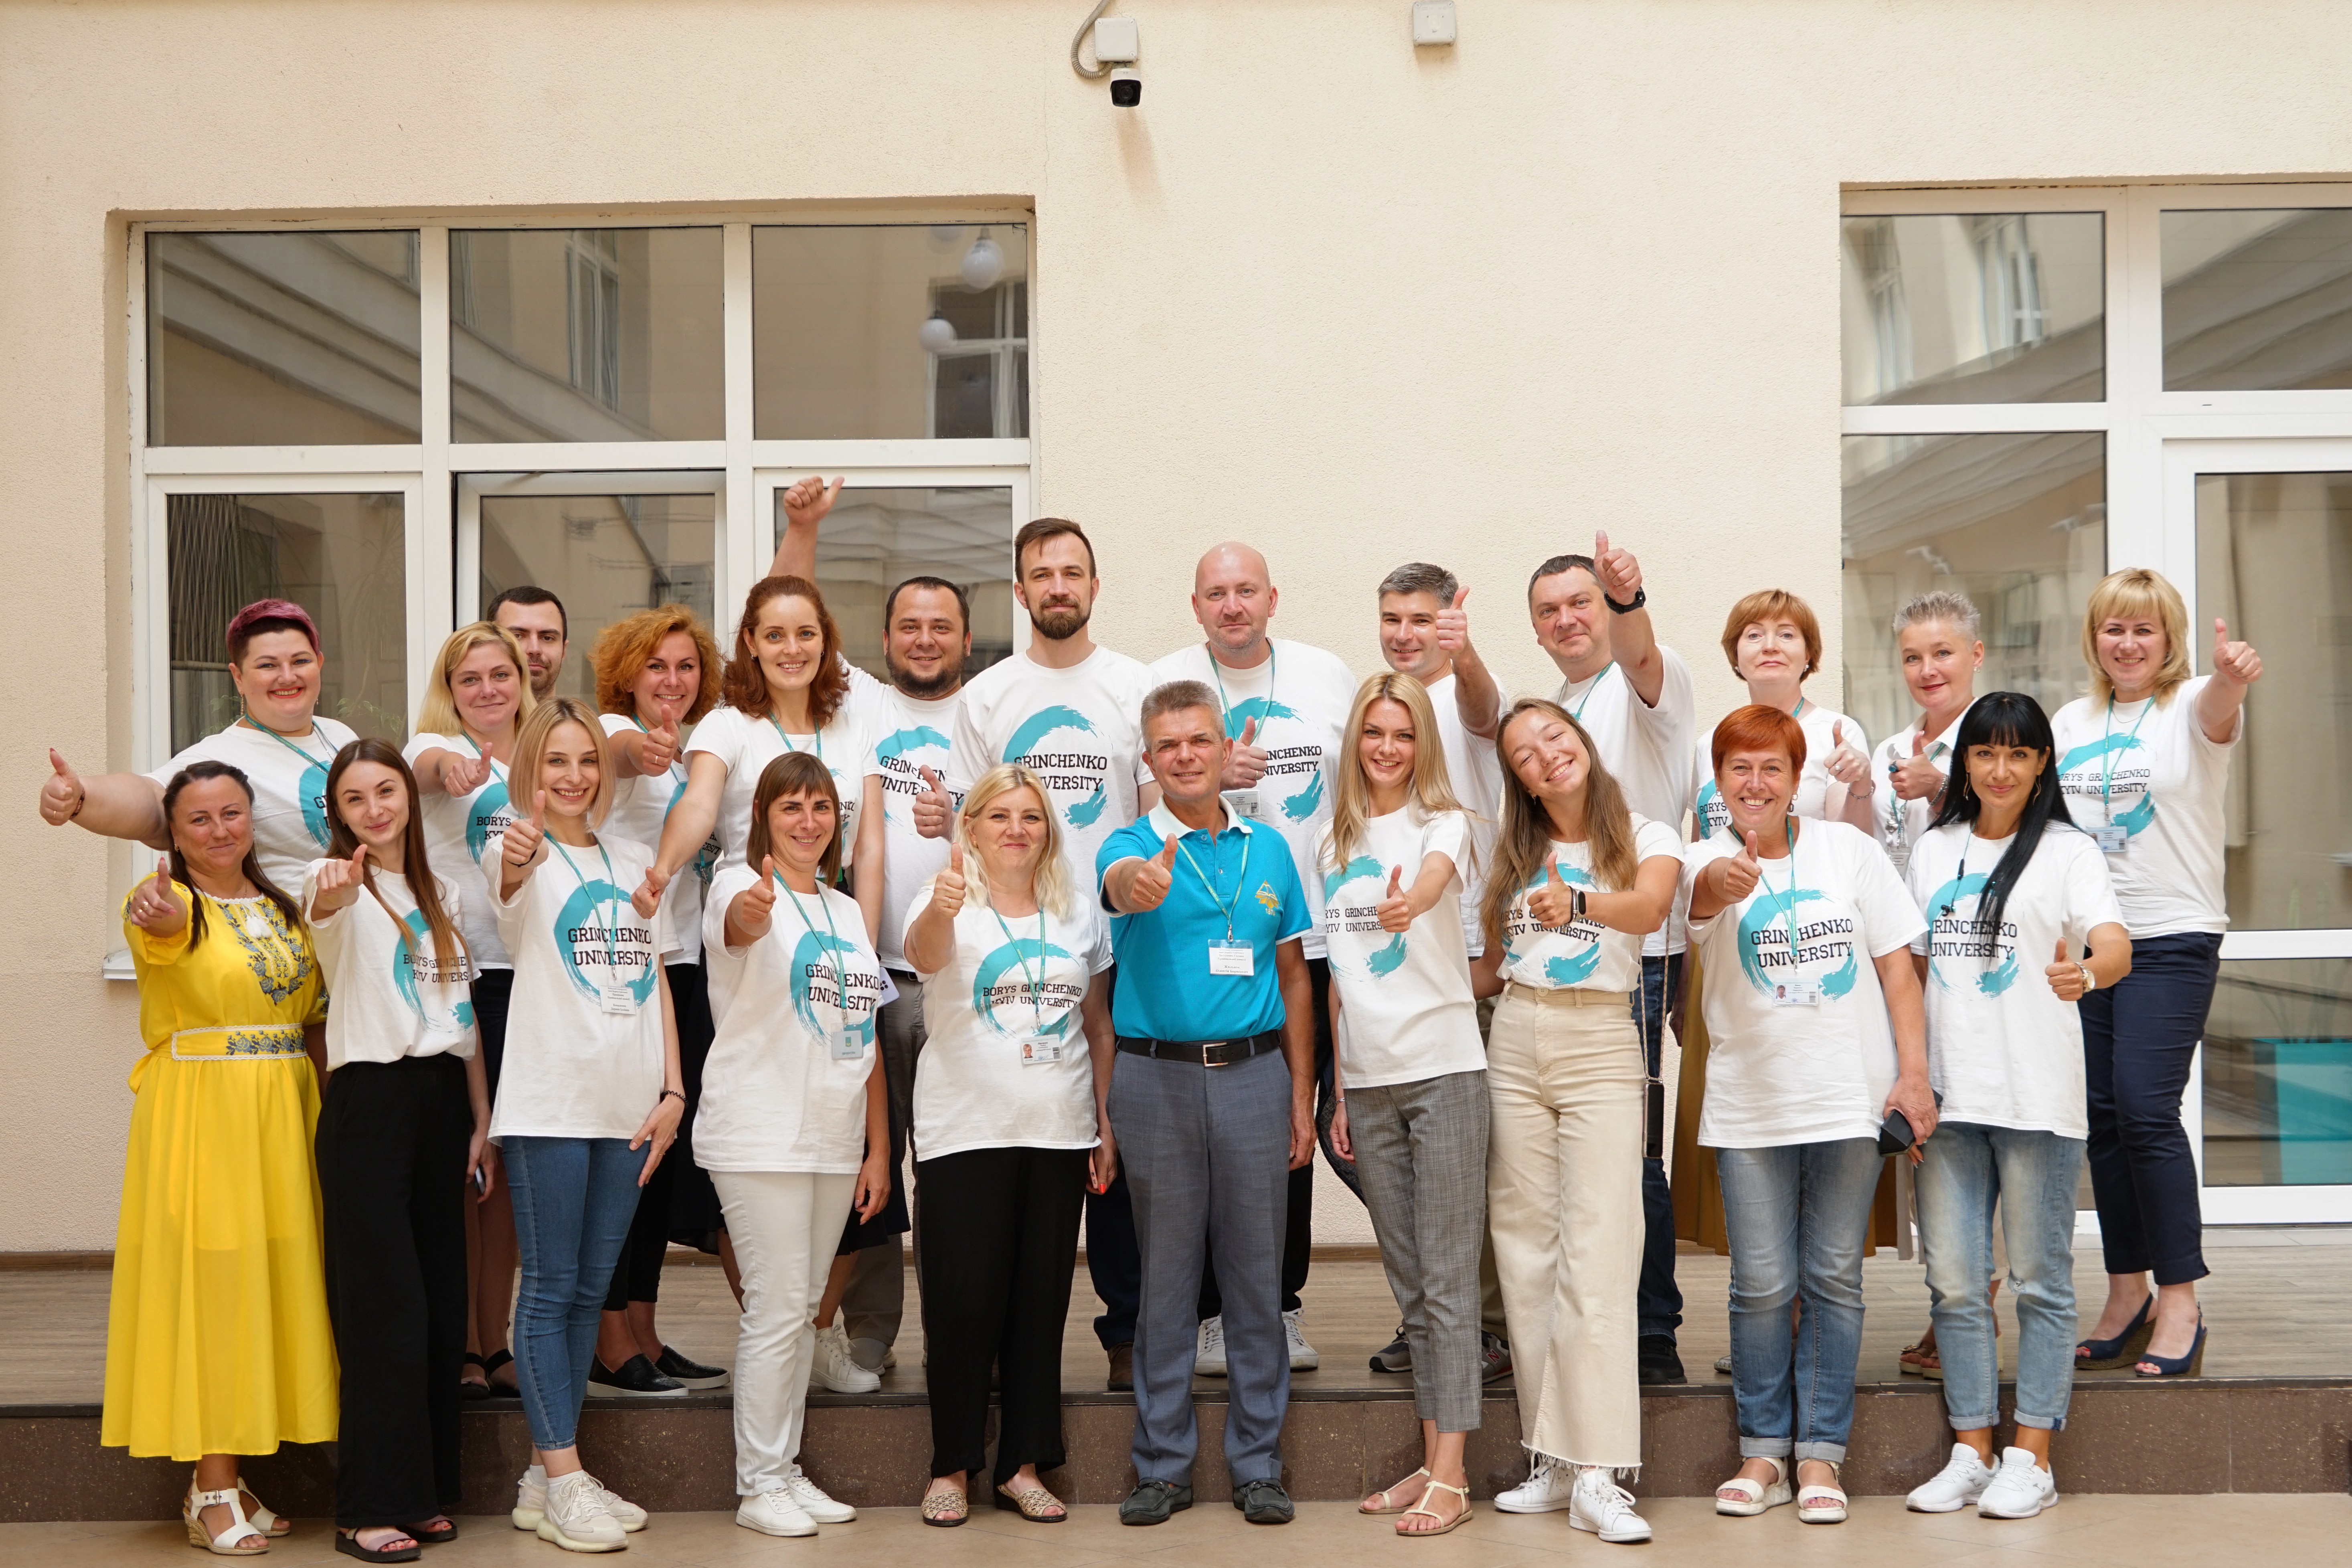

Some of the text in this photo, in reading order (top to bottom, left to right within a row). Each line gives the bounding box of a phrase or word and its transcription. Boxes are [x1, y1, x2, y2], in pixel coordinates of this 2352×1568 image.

[1699, 802, 1727, 815] BORYS
[476, 816, 511, 826] BORYS
[1751, 919, 1853, 945] GRINHENKO
[983, 985, 1016, 996] BORYS
